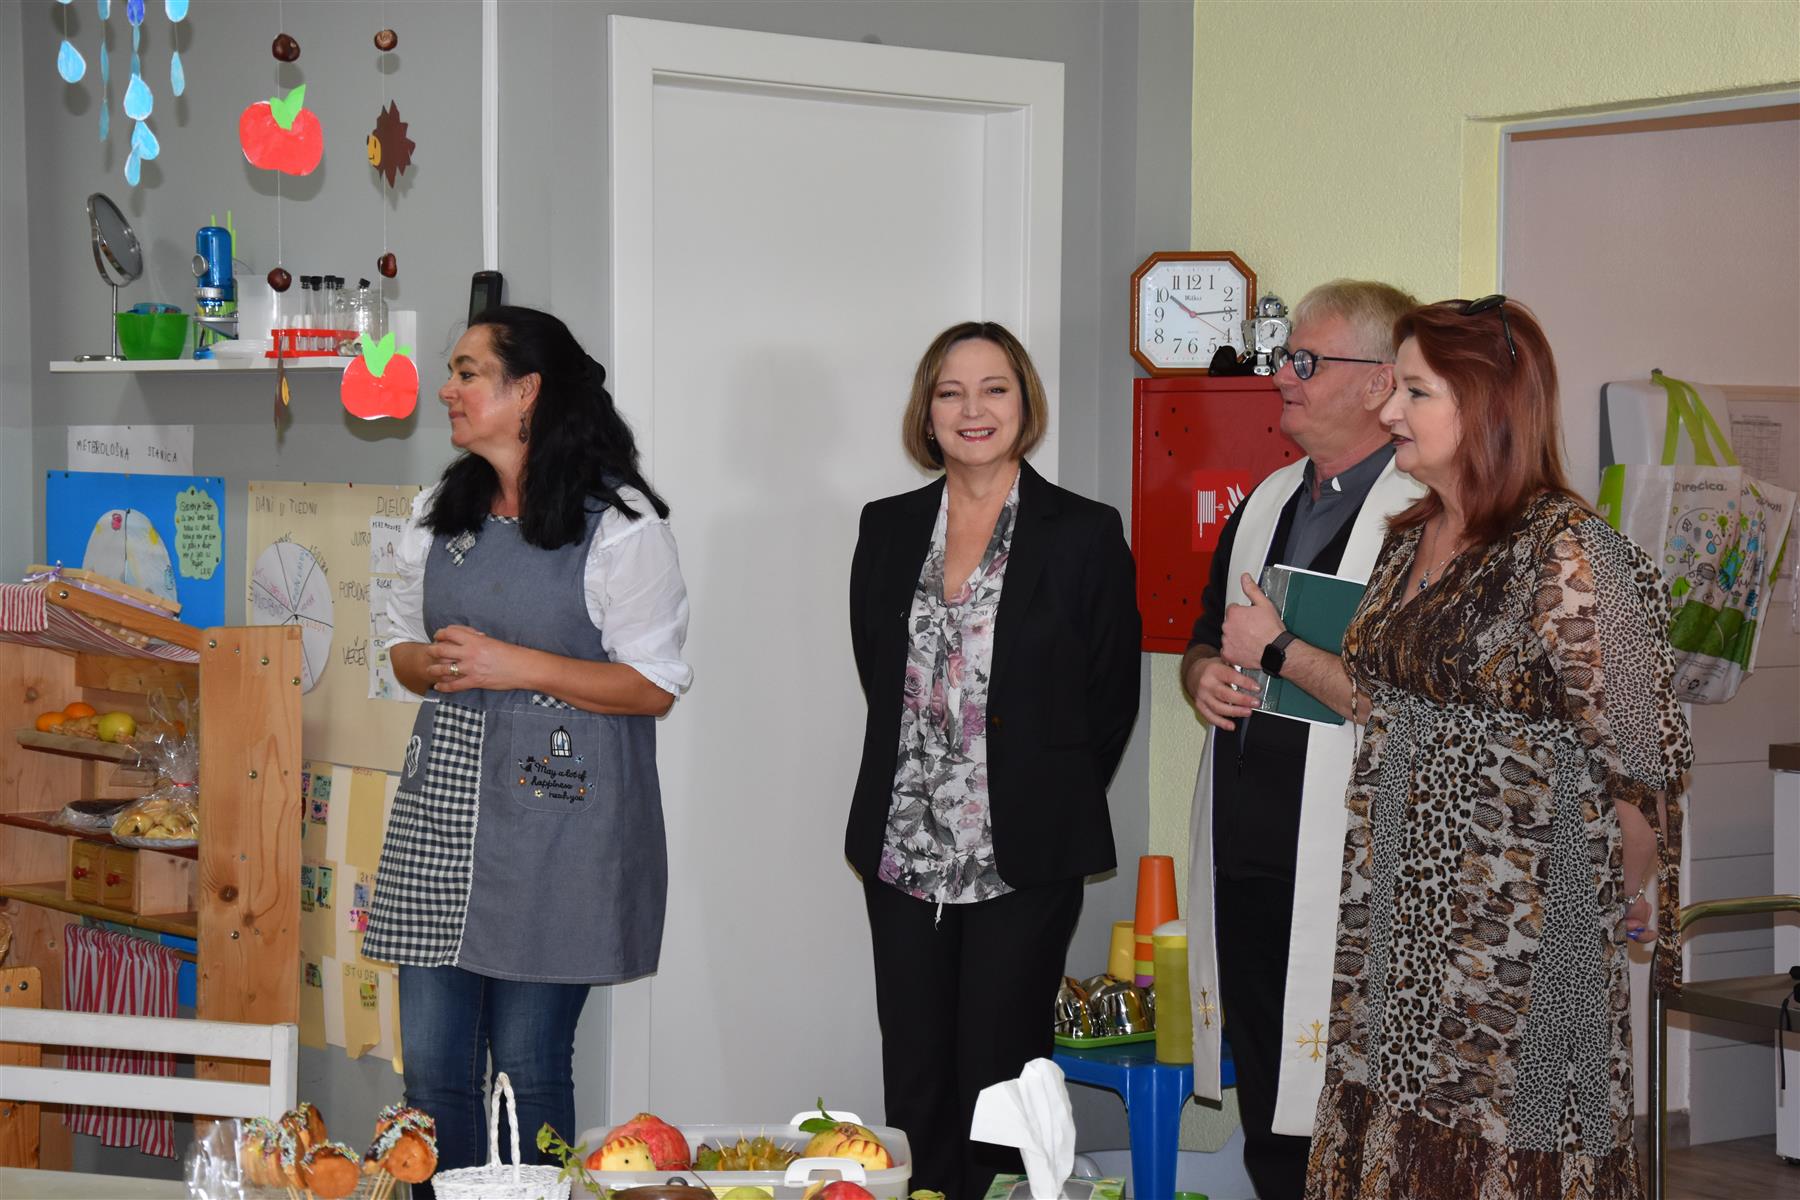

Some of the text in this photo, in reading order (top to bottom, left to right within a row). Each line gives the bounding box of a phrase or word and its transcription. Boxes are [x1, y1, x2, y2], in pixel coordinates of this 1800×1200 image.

[1173, 274, 1215, 290] 11 12 1
[1156, 288, 1170, 303] 10
[1224, 286, 1233, 302] 2
[1154, 307, 1165, 323] 9
[1222, 306, 1233, 322] 3
[1154, 328, 1164, 344] 8
[1222, 327, 1232, 343] 4
[1174, 338, 1182, 354] 7
[1188, 337, 1198, 354] 6
[1208, 337, 1217, 354] 5
[534, 762, 556, 780] May
[531, 775, 573, 790] happiness
